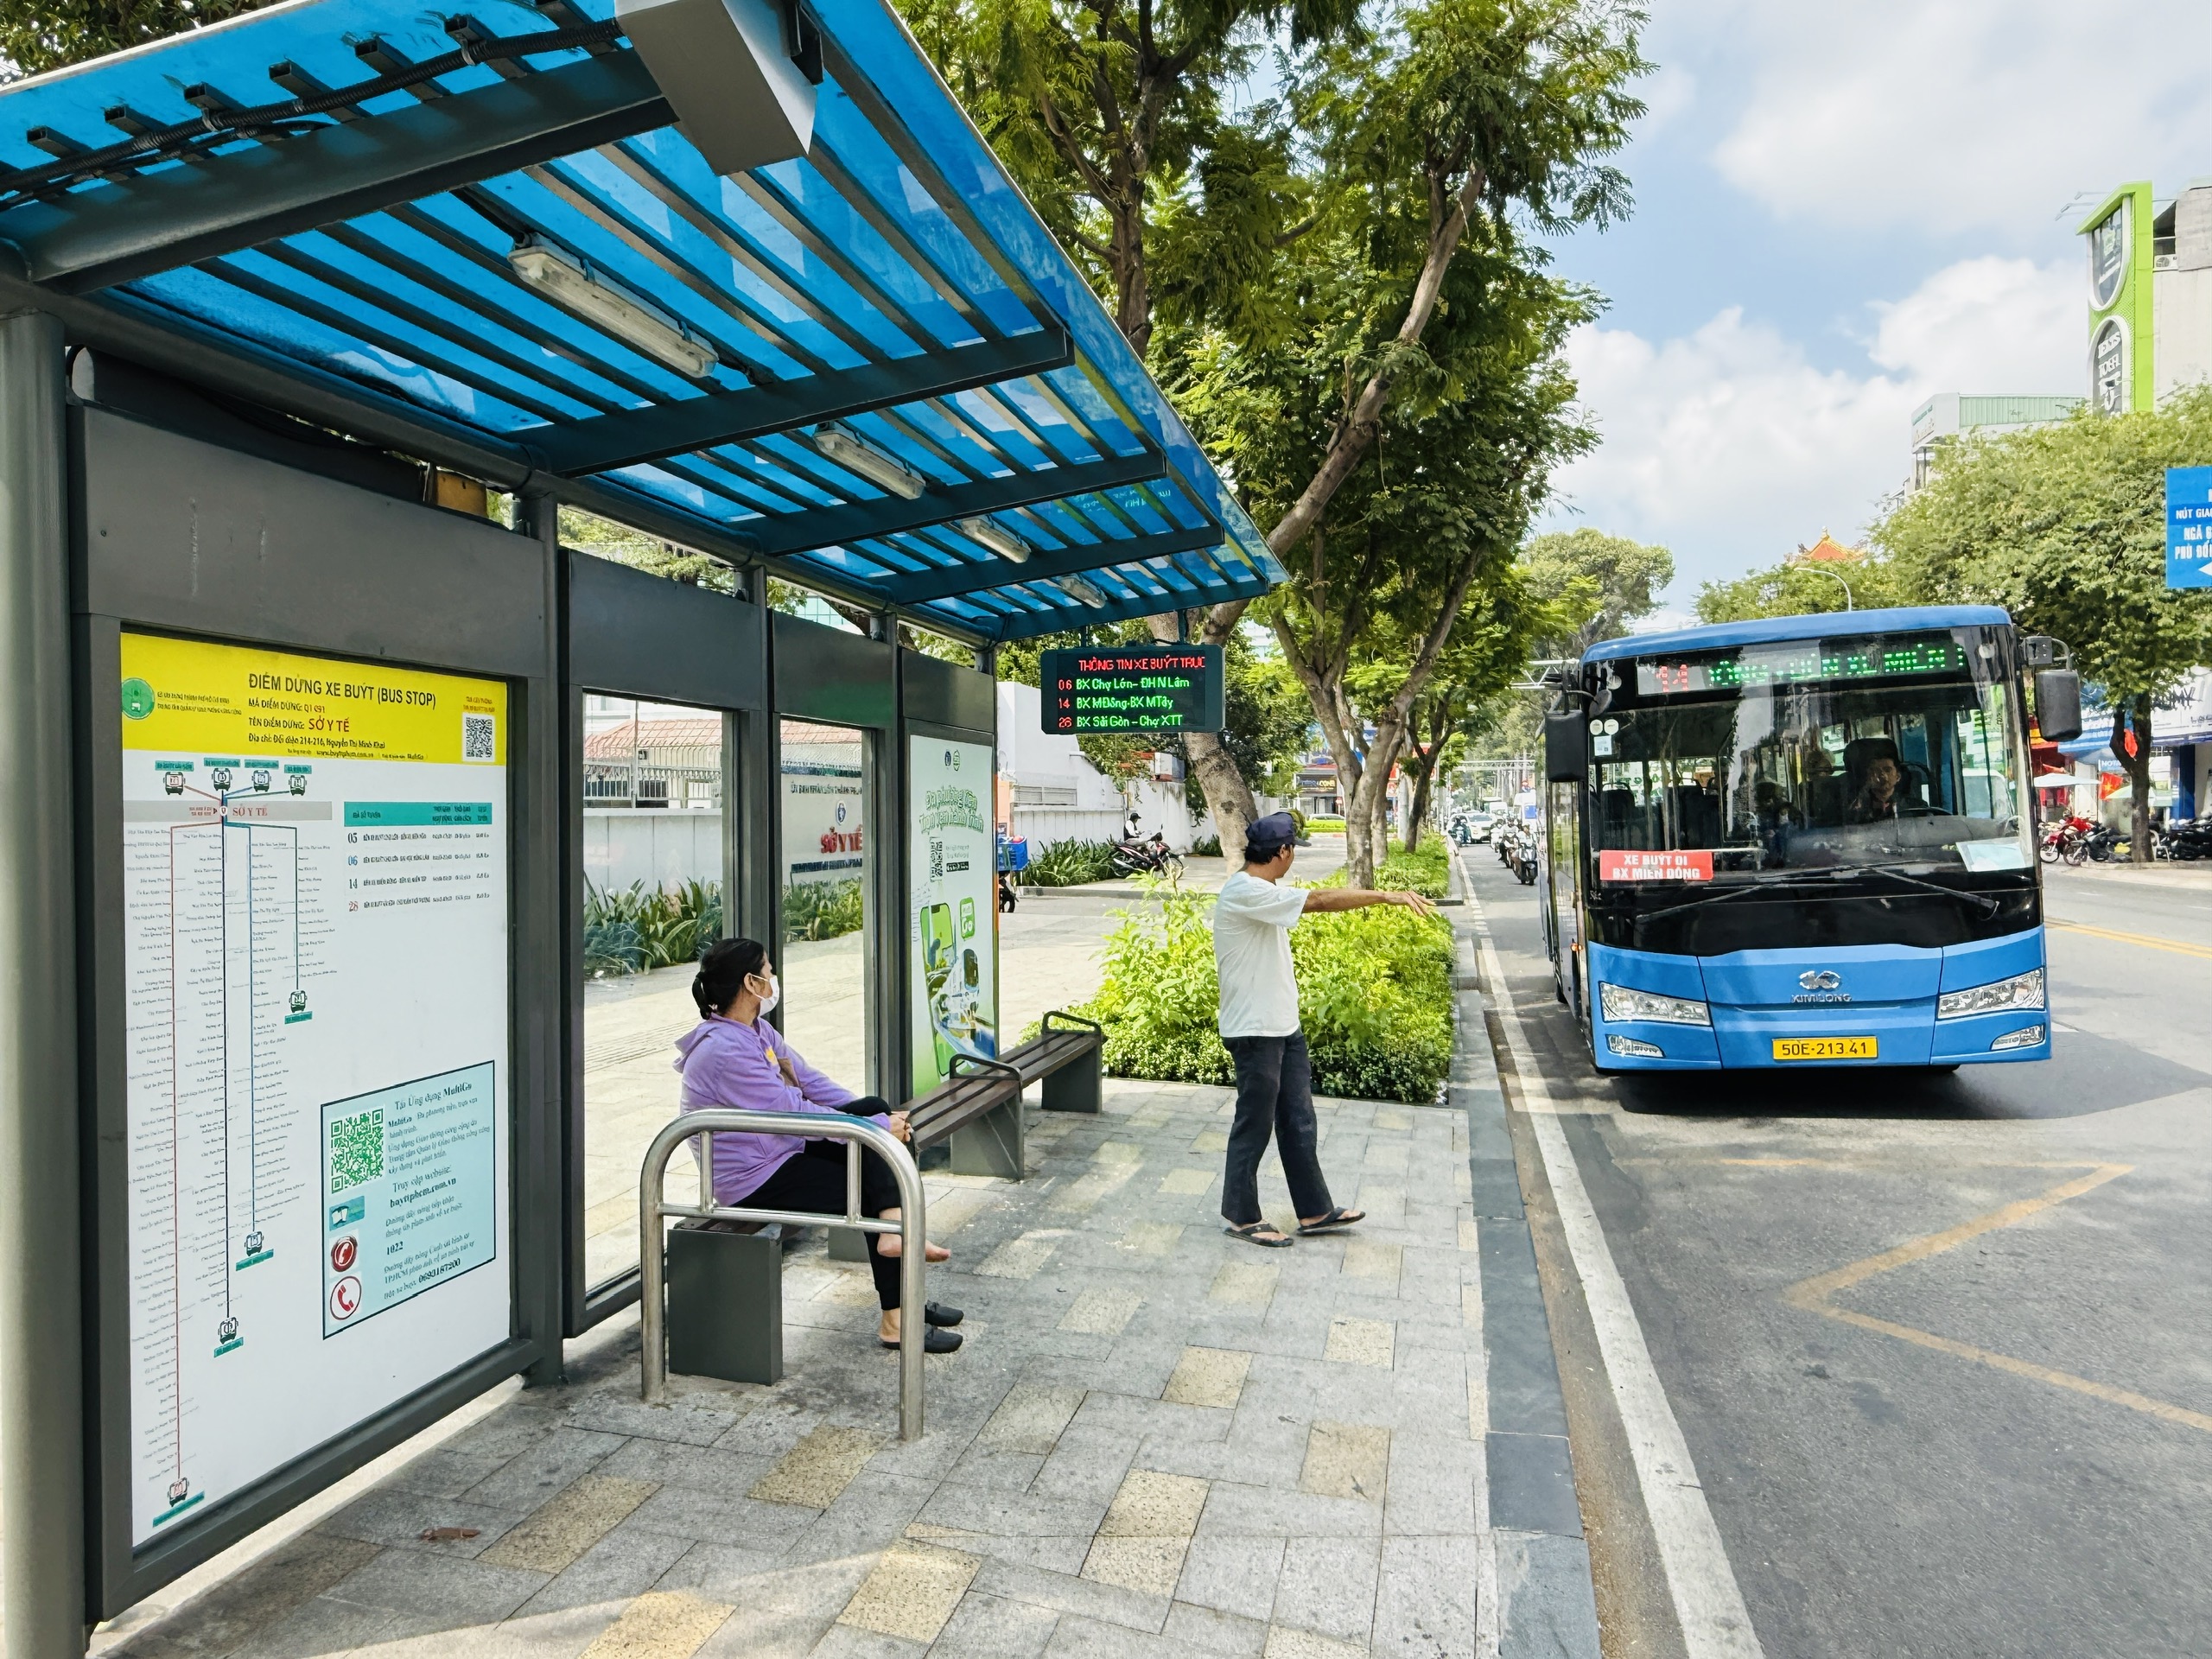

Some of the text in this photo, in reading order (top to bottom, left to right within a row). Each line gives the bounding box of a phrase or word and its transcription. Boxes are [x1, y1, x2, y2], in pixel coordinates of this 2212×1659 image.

[2176, 506, 2212, 518] NÚT GIA
[2184, 524, 2203, 540] NGÃ
[2175, 543, 2193, 560] PHÙ
[1078, 657, 1115, 671] THÔNG
[1116, 658, 1132, 670] TIN
[1134, 658, 1149, 669] XE
[1150, 655, 1179, 669] BUÝT
[1058, 679, 1071, 690] 06
[1077, 677, 1090, 690] BX
[1092, 677, 1111, 691] Chợ
[1141, 677, 1156, 688] ĐH
[1168, 677, 1189, 688] Lâm
[249, 672, 435, 710] ĐIỂM DỪNG XE BUÝT (BUS STOP)
[1059, 698, 1070, 709] 14
[1077, 697, 1090, 709] BX
[308, 715, 325, 731] SỞ
[327, 719, 334, 731] Y
[336, 717, 349, 733] TẾ
[1077, 716, 1090, 728] BX
[1109, 715, 1128, 728] Gòn
[1140, 715, 1160, 728] Chợ
[1161, 715, 1182, 726] XTT
[247, 807, 253, 817] Y
[347, 833, 358, 843] 05
[821, 826, 838, 854] SỞ
[838, 834, 847, 852] Y
[347, 855, 358, 866] 06
[1624, 855, 1638, 866] XE
[1642, 854, 1672, 866] BUÝT
[1612, 868, 1628, 879] BX
[443, 1082, 472, 1097] MultiGo
[393, 1180, 409, 1192] Truy
[387, 1241, 403, 1255] 1022
